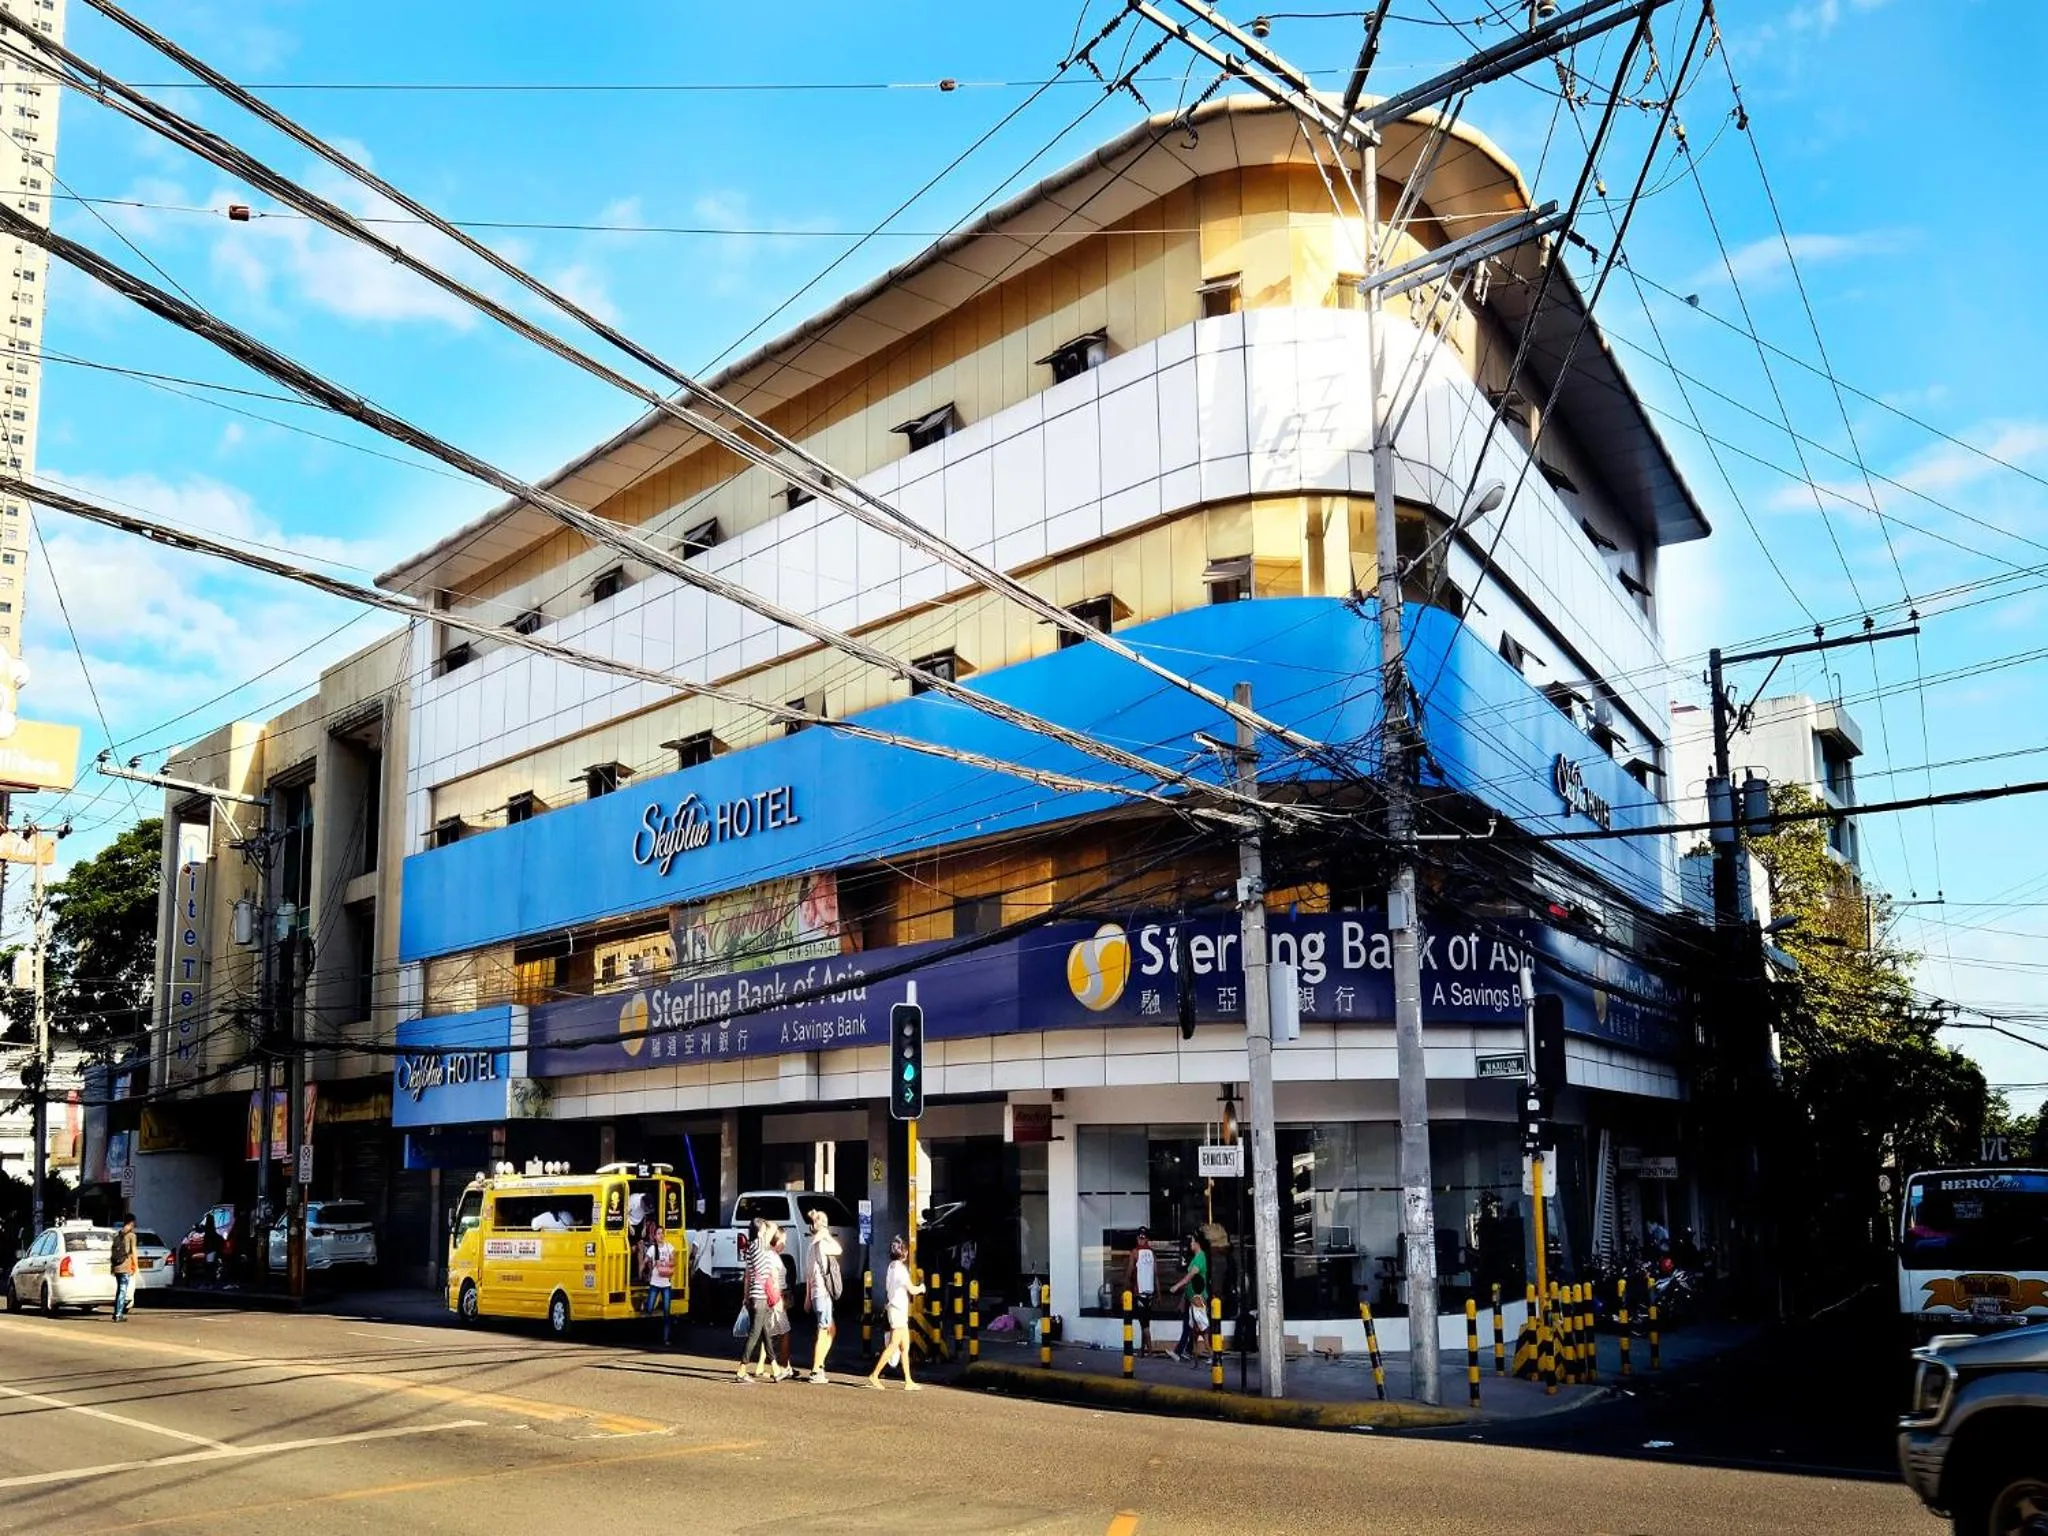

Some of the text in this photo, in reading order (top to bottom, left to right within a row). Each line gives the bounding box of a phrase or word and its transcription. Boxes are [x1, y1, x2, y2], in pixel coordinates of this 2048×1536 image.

[632, 785, 799, 876] Skyblue HOTEL
[1140, 924, 1327, 985] Sterng
[1342, 921, 1439, 970] Bak
[652, 981, 732, 1029] Sterling
[738, 972, 787, 1012] Bank
[794, 965, 816, 1008] of
[820, 962, 867, 1005] Asia
[1432, 982, 1446, 1006] A
[1450, 982, 1510, 1012] Savings
[781, 1013, 867, 1044] A Savings Bank
[447, 1052, 497, 1085] HOTEL
